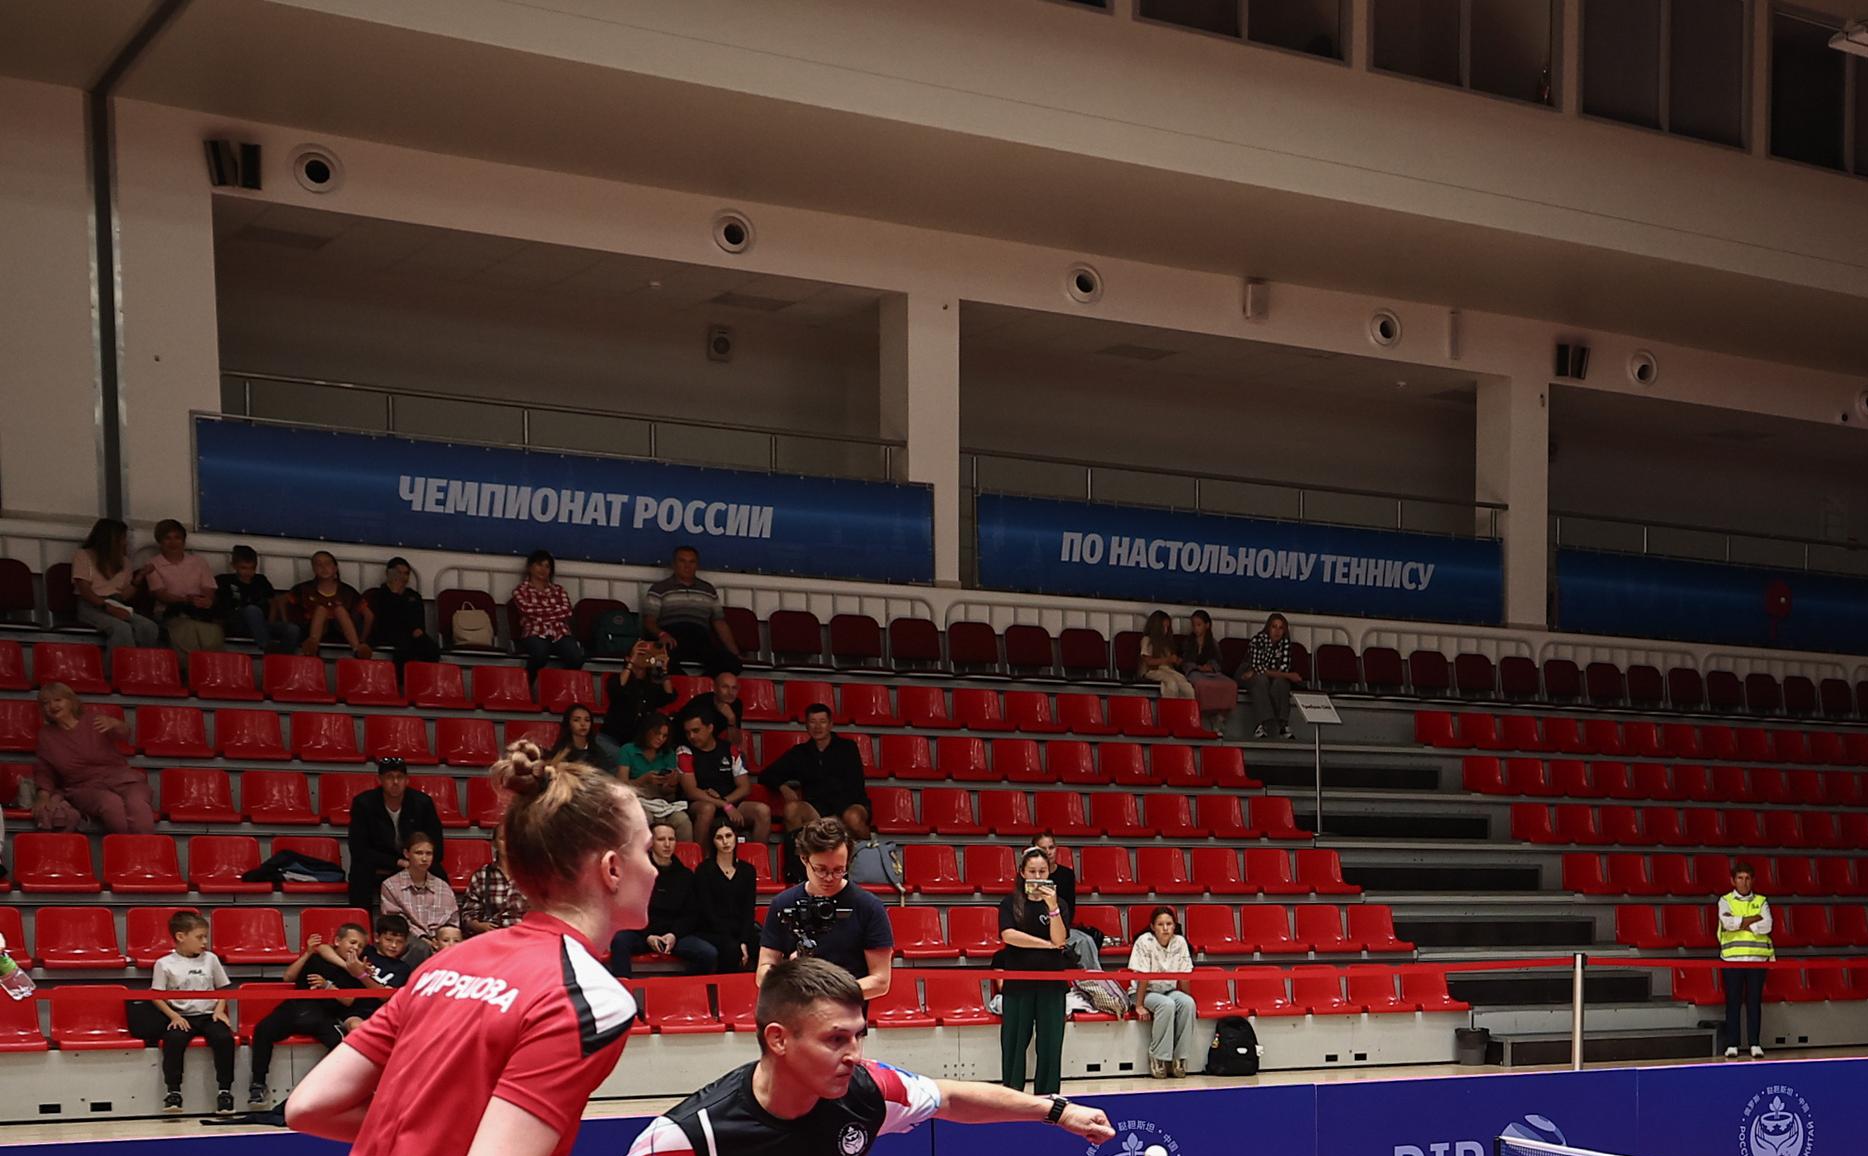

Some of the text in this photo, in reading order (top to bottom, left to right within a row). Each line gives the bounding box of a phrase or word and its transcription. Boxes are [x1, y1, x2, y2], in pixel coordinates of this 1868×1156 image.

[399, 475, 774, 538] ЧЕМПИОНАТ РОССИИ
[1060, 532, 1434, 591] ПО НАСТОЛЬНОМУ ТЕННИСУ
